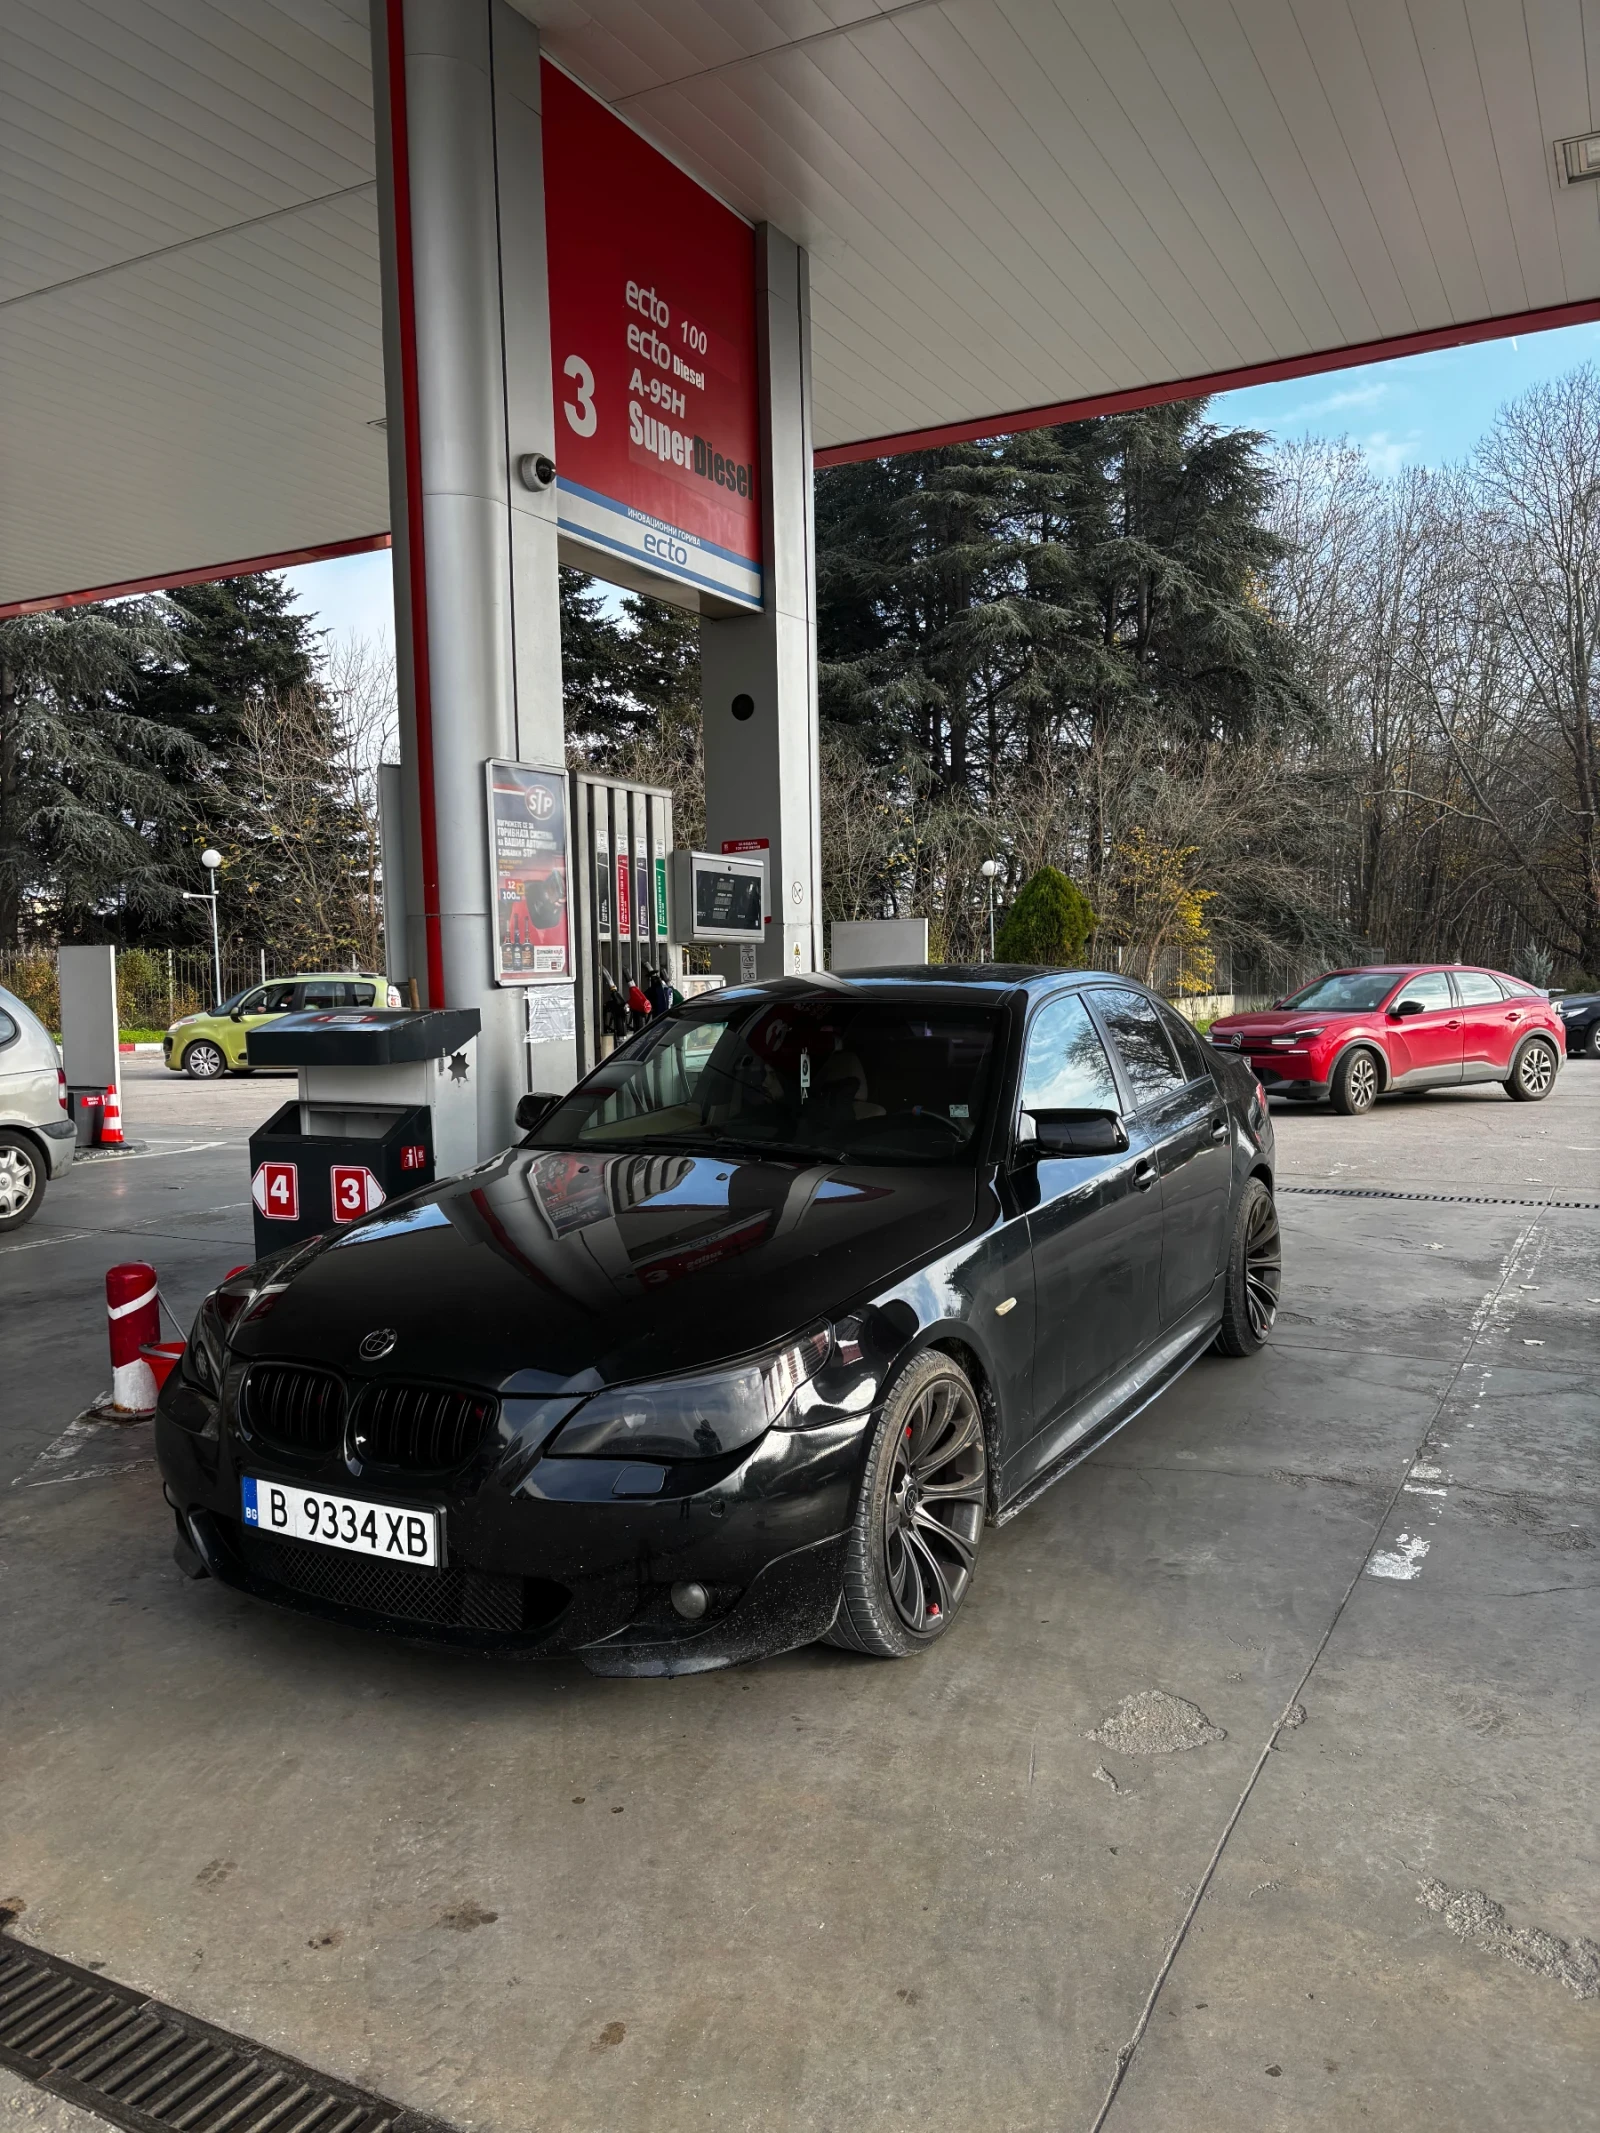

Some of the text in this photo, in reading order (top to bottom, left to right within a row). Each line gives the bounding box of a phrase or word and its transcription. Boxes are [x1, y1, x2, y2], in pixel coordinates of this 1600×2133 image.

[626, 280, 707, 355] ecto 100
[627, 323, 705, 391] ecto Diesel
[563, 354, 597, 437] 3
[629, 367, 685, 419] A-95H
[627, 507, 701, 546] ИНОВАЦИОННИ ГОРИВА
[644, 533, 687, 565] ecto
[528, 788, 552, 814] STP
[502, 891, 516, 900] 100
[507, 881, 516, 890] 12
[270, 1174, 290, 1205] 4
[341, 1178, 361, 1209] 3
[245, 1507, 258, 1520] BG
[271, 1488, 287, 1528] B
